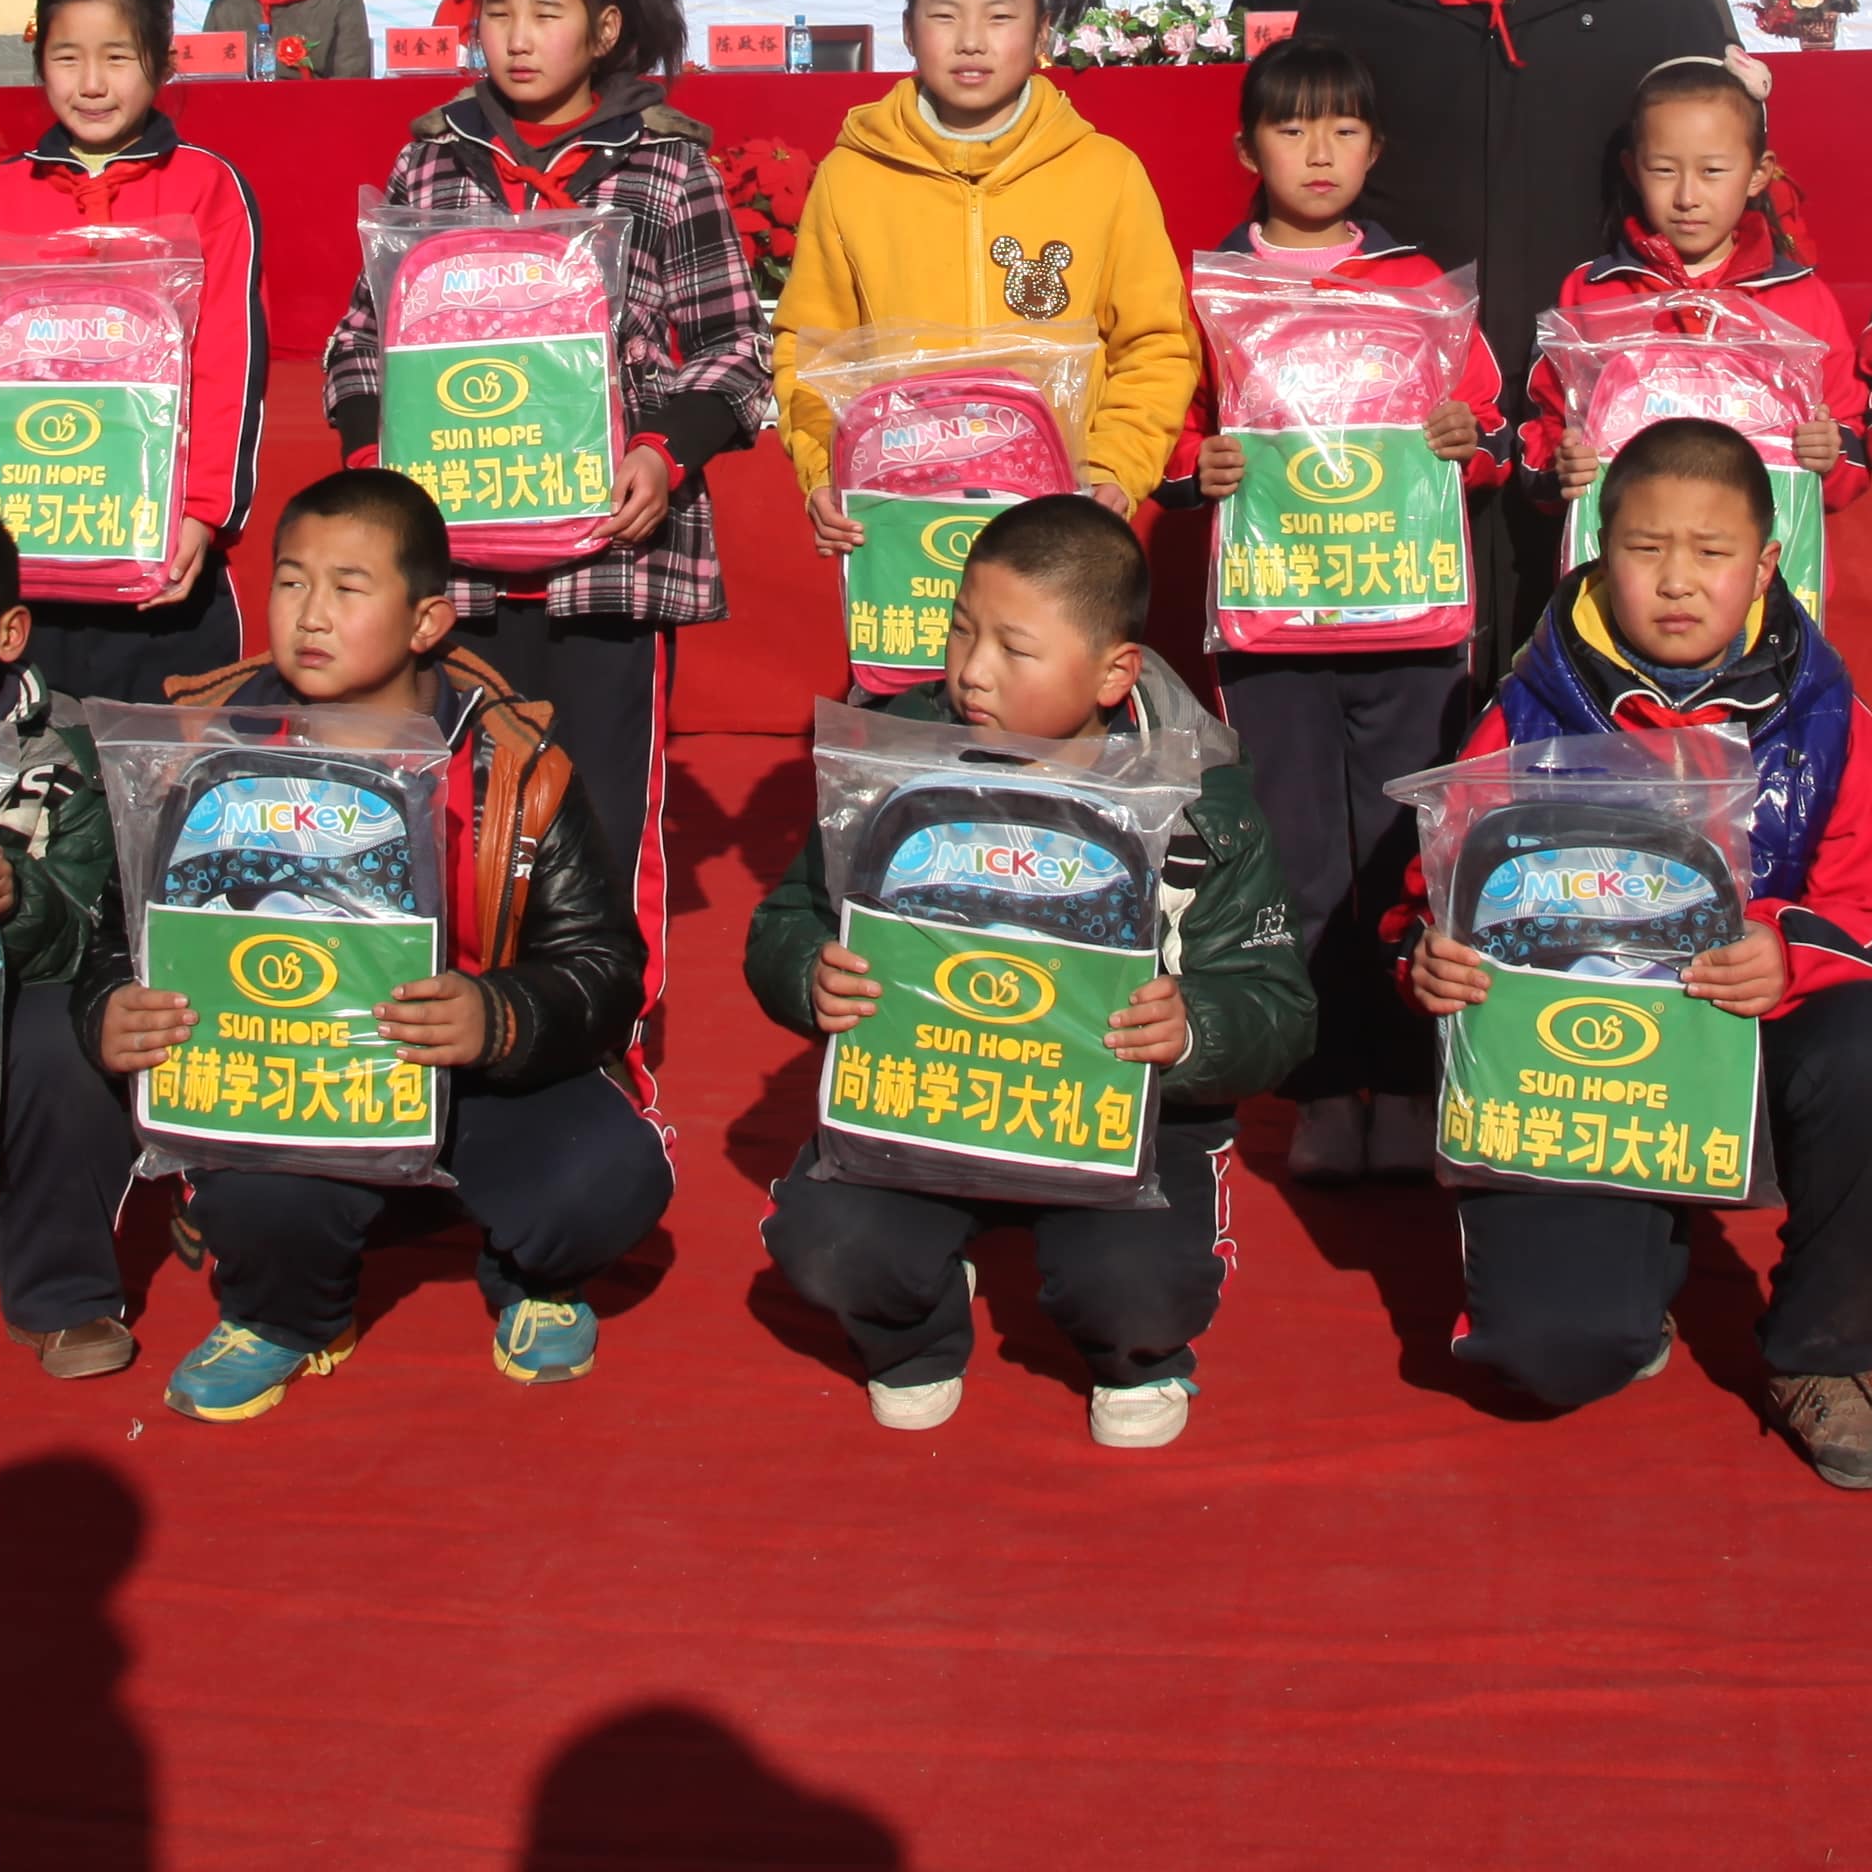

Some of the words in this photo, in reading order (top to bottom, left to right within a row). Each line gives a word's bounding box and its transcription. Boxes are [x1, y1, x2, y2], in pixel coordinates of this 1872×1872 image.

[478, 424, 543, 449] HOPE
[46, 465, 107, 486] HOPE
[1328, 511, 1396, 535] HOPE
[1224, 539, 1461, 598] 尚赫学习大礼包
[270, 1016, 350, 1048] HOPE
[979, 1034, 1064, 1069] HOPE
[150, 1045, 429, 1124] 尚赫学习大礼包
[833, 1044, 1134, 1152] 尚赫学习大礼包
[1582, 1075, 1669, 1110] HOPE
[1443, 1085, 1743, 1188] 尚赫学习大礼包
